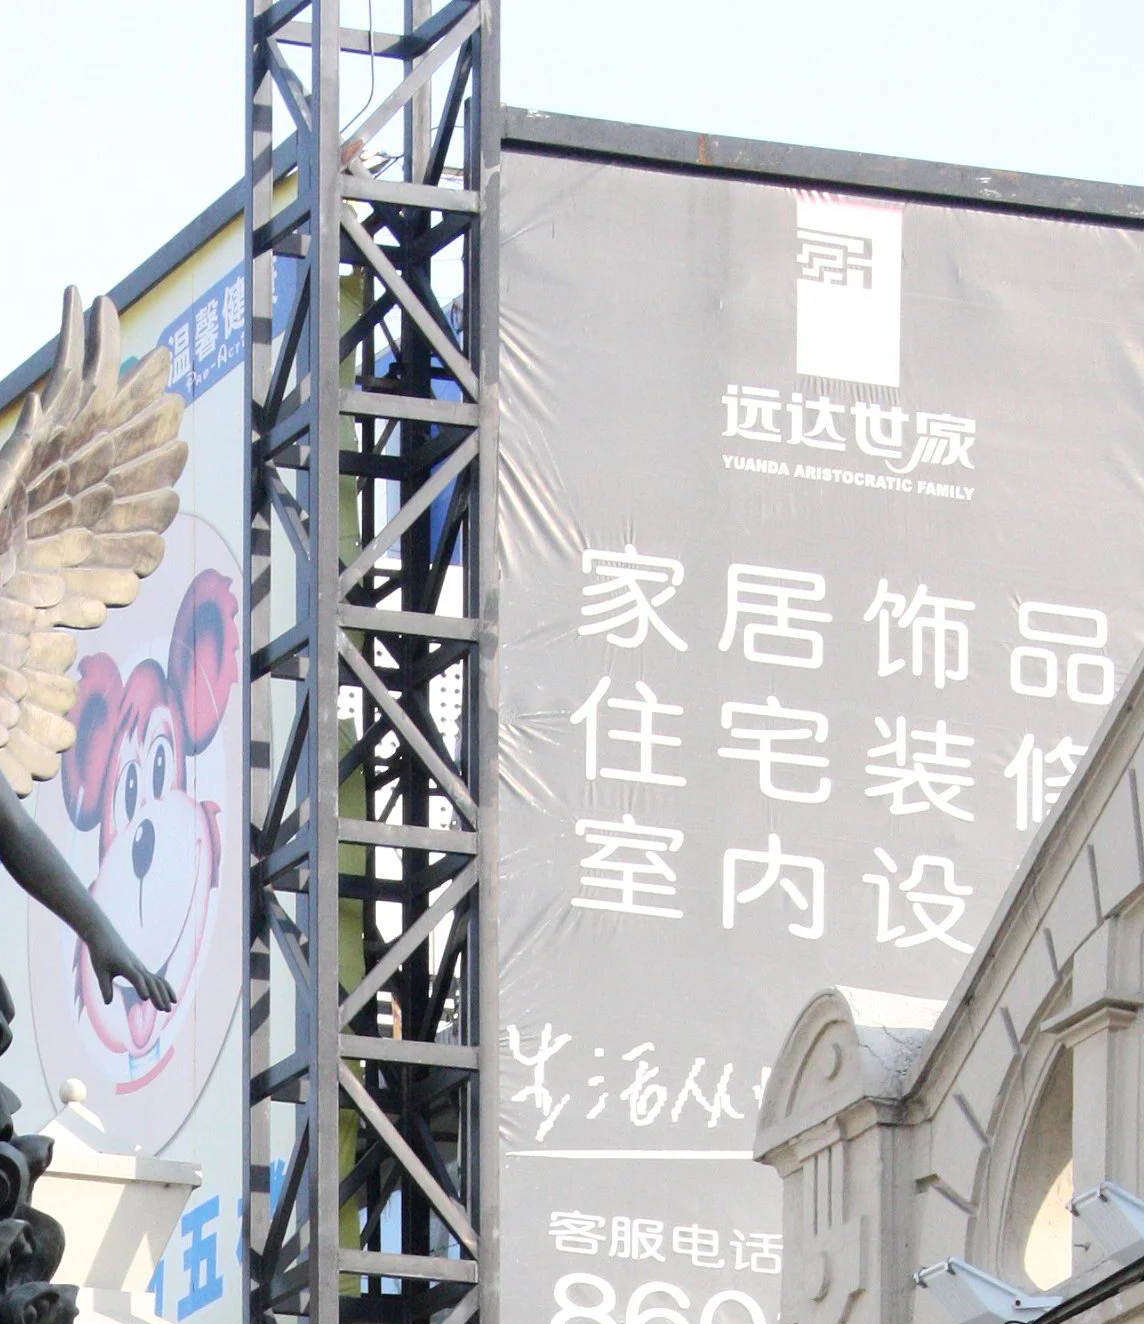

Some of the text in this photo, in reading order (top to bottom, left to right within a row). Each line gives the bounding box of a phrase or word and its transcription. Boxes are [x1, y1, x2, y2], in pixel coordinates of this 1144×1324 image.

[721, 384, 975, 474] 远达世家
[721, 454, 975, 501] YUANDA ARISTOCRATIC FAMILY
[578, 543, 1115, 705] 家居饰品
[570, 813, 975, 954] 室内设
[507, 1022, 772, 1142] 生活从
[548, 1209, 783, 1275] 客服电话
